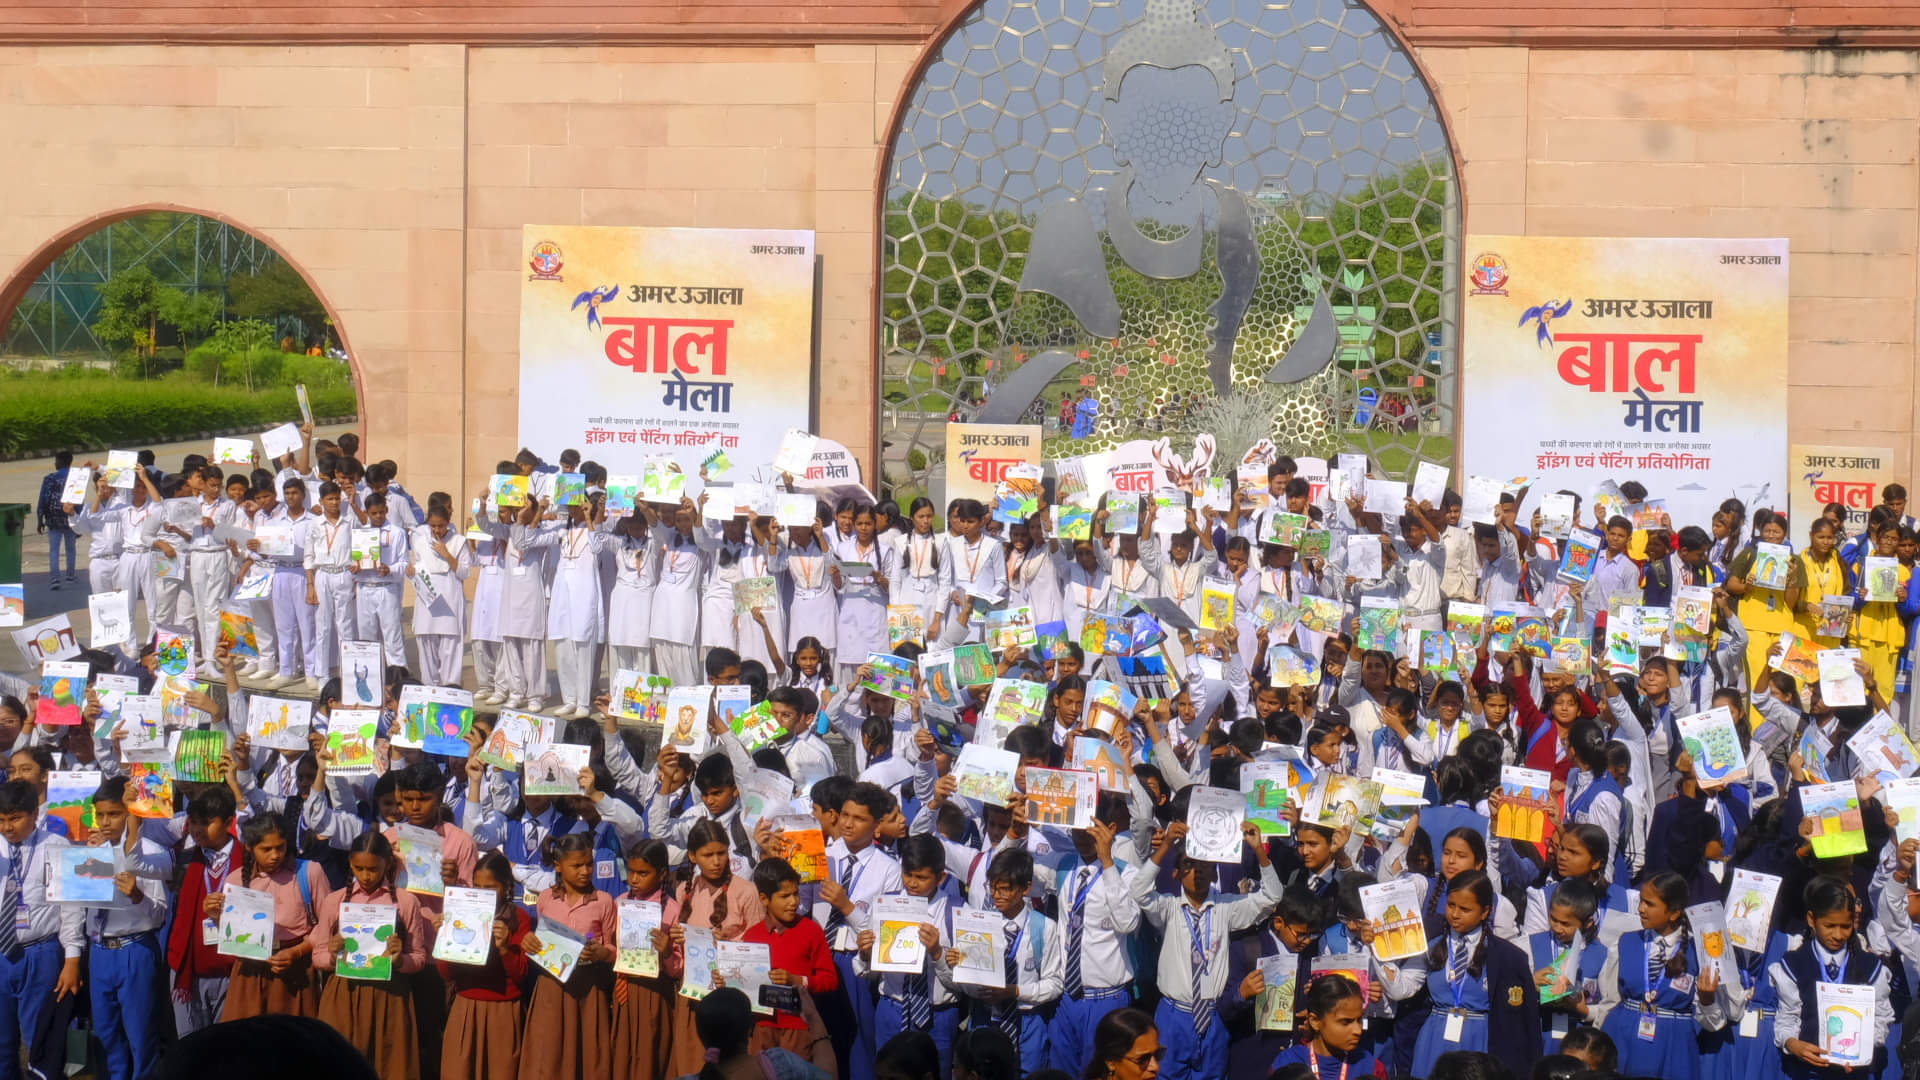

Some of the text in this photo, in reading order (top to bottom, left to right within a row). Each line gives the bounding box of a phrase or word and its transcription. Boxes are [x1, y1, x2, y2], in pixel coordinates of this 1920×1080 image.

[750, 245, 804, 255] अमर उजाला
[1720, 255, 1781, 265] अमर उजाला
[627, 285, 743, 305] अमर उजाला
[1582, 299, 1712, 319] अमर उजाला
[602, 316, 734, 375] बाल
[1554, 333, 1702, 393] बाल
[662, 368, 733, 413] मेला
[1623, 387, 1703, 433] मेला
[619, 429, 636, 443] एवं
[960, 434, 1029, 446] अमर उजाला
[825, 461, 848, 478] मेला
[1536, 451, 1711, 470] ड्रॉइंग एवं पेंटिंग प्रतियोगिता
[1803, 455, 1880, 470] अमर उजाला
[1114, 471, 1154, 491] बाल
[1815, 481, 1876, 509] बाल
